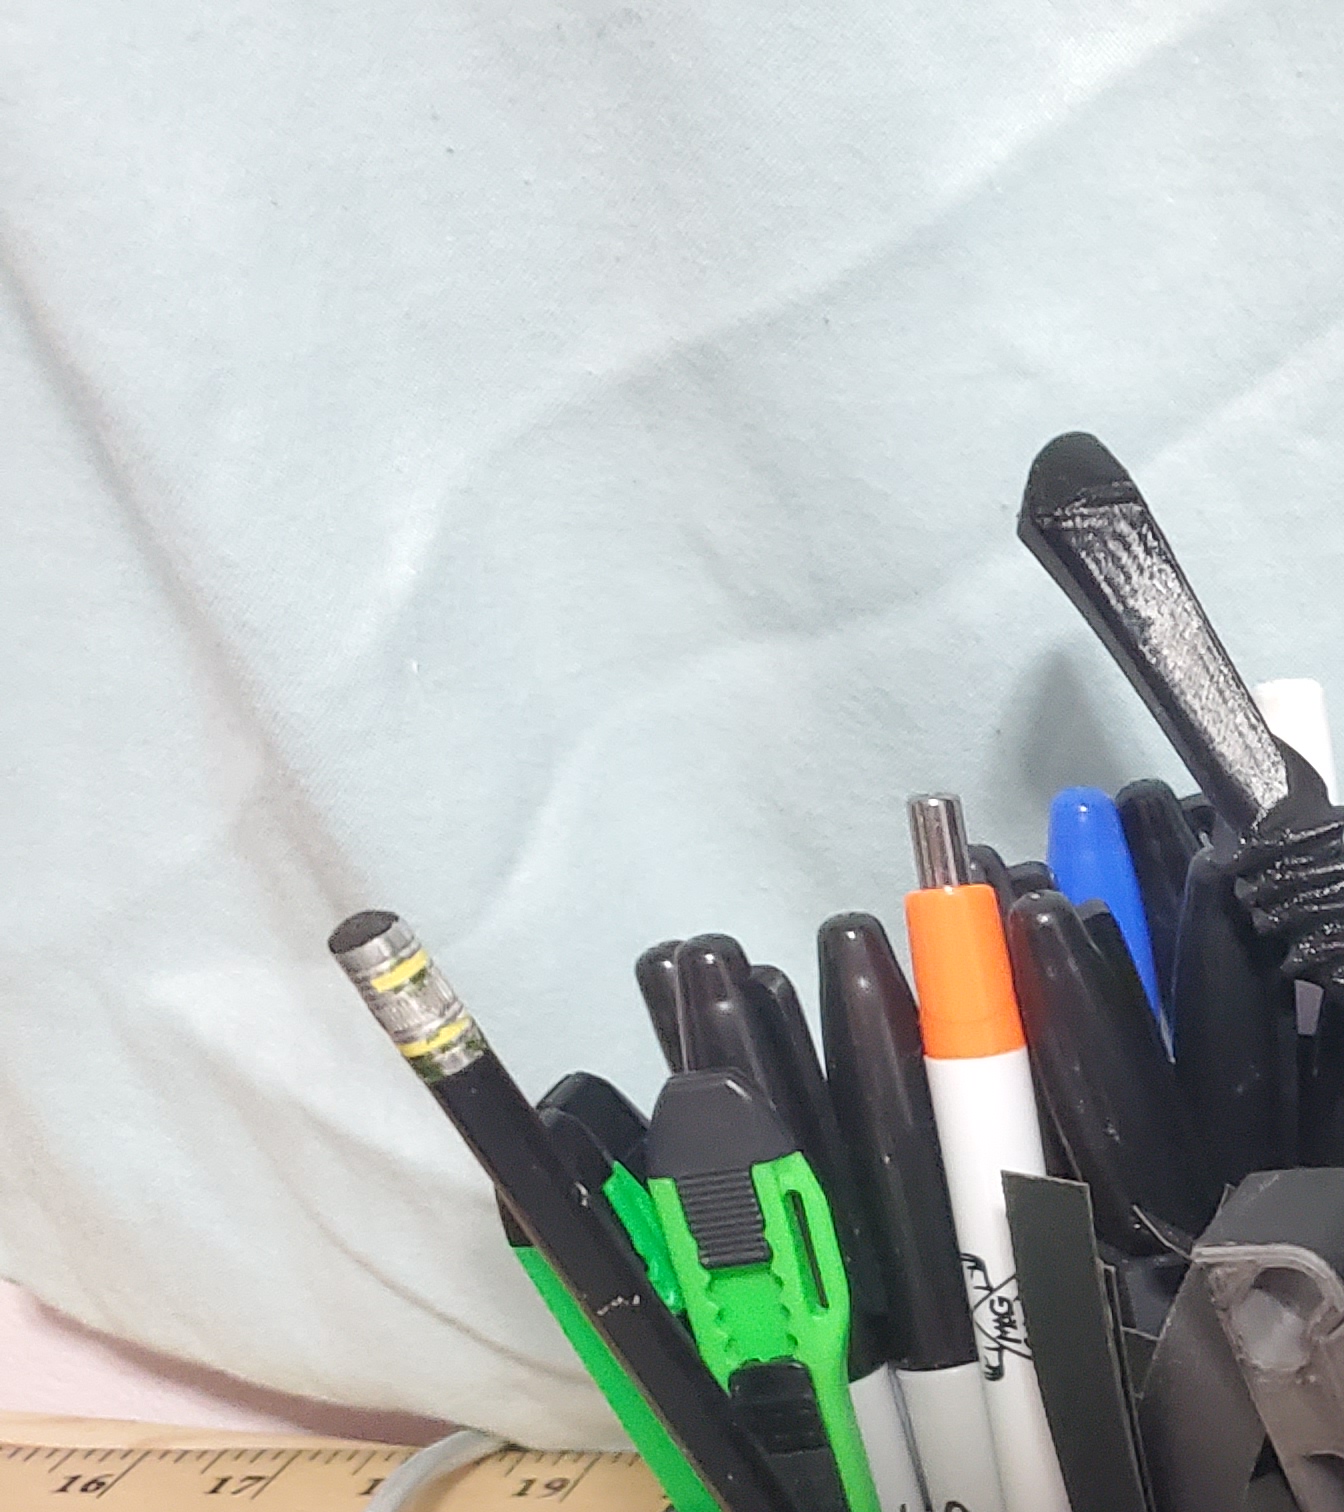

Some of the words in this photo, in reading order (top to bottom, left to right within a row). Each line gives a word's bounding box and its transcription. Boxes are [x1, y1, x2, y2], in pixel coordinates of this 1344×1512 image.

[51, 1473, 114, 1493] 16
[204, 1475, 270, 1494] 17
[511, 1477, 570, 1498] 19
